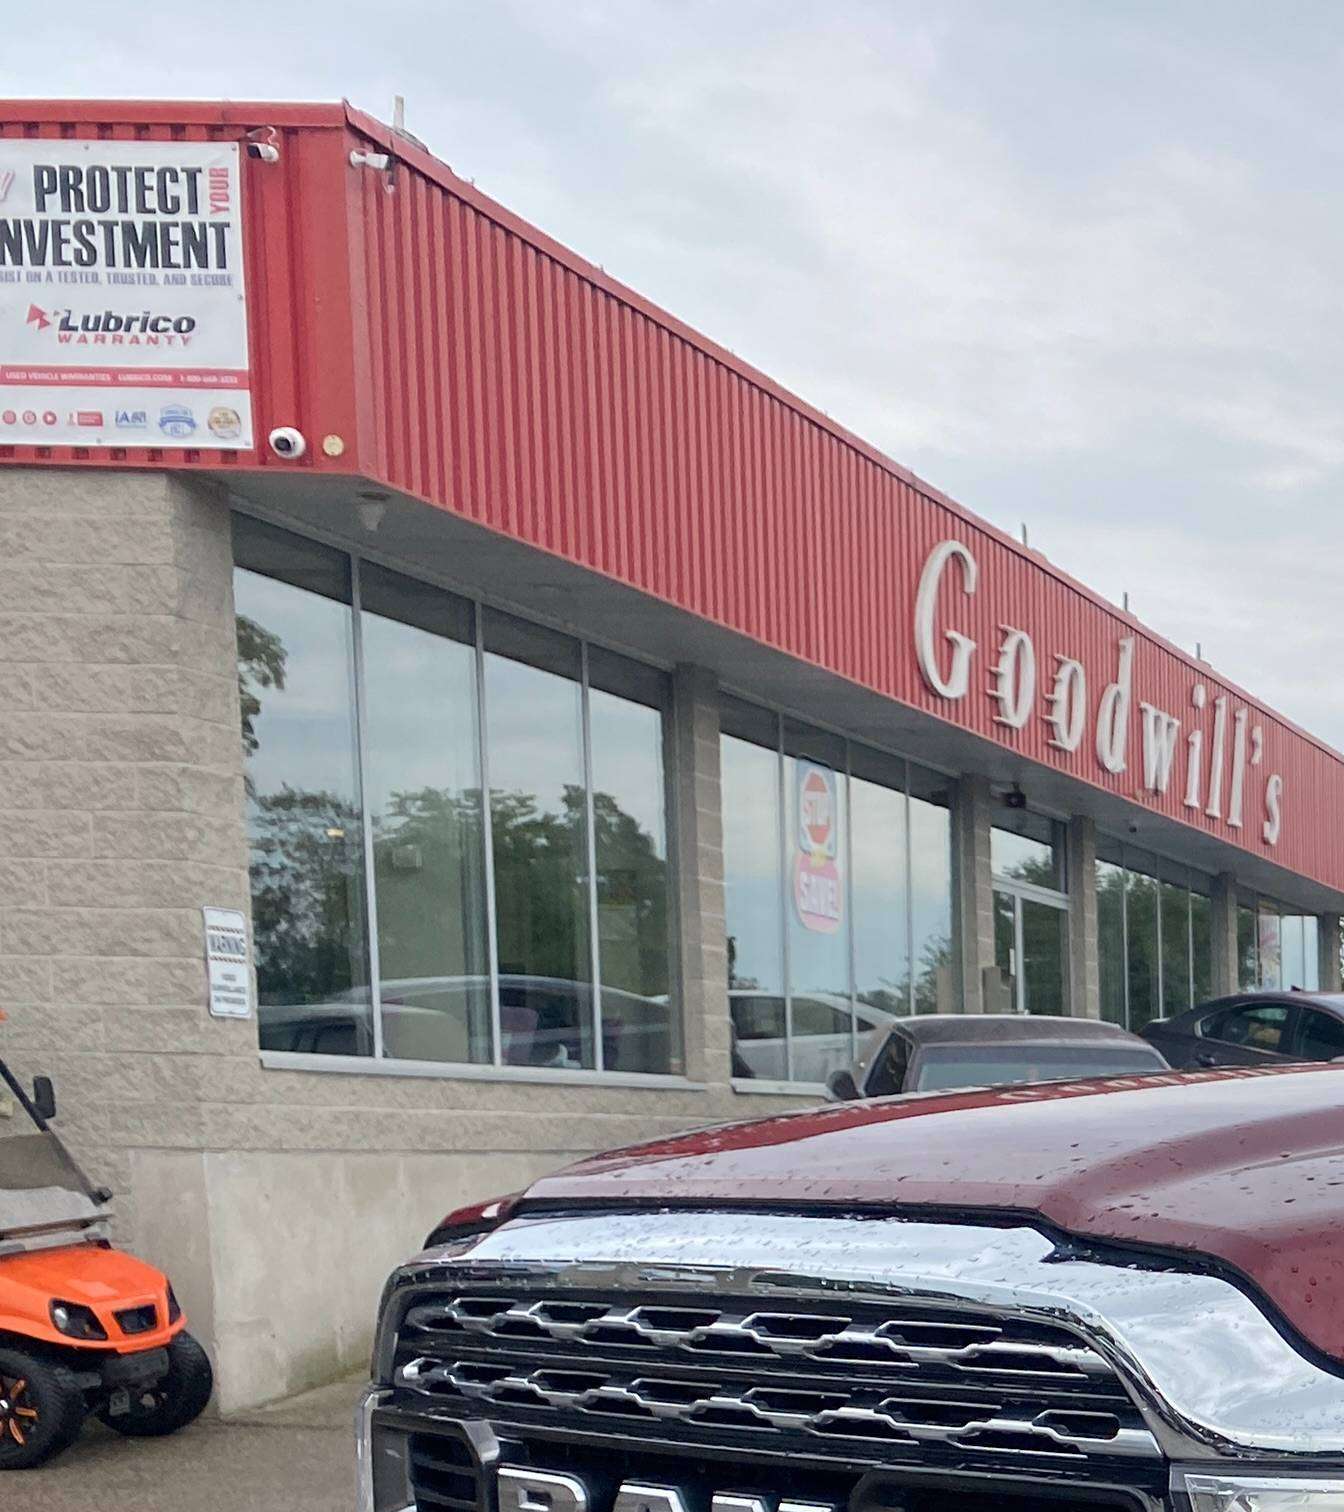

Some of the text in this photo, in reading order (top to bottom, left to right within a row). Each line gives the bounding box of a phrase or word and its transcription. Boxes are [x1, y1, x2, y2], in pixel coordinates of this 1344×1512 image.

[33, 165, 202, 215] PROTECT
[209, 167, 230, 215] YOUR
[0, 218, 231, 269] NVESTMENT
[45, 271, 53, 284] A
[163, 273, 186, 287] AND
[58, 334, 193, 346] WARRANTY
[59, 309, 196, 334] Lubrico
[914, 540, 1283, 845] Goodwill's
